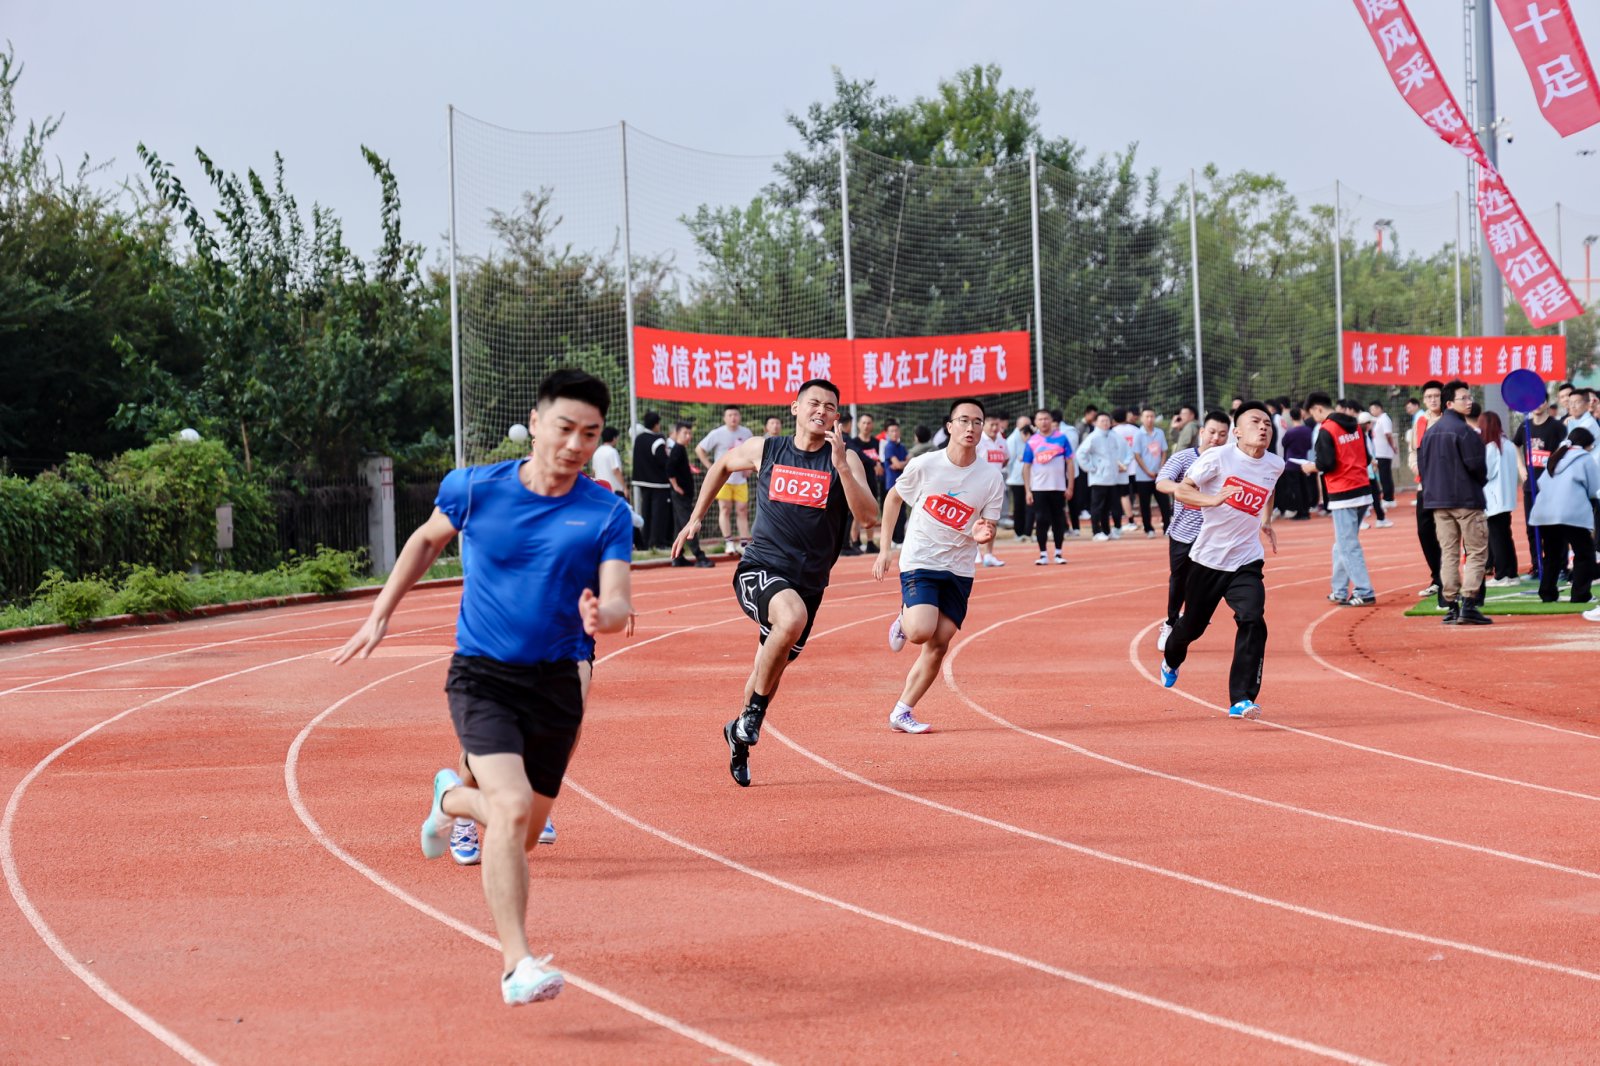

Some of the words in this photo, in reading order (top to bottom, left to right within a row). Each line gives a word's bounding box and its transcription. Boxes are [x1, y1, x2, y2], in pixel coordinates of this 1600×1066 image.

[1513, 2, 1588, 108] 十足
[650, 343, 832, 393] 激情在运动中点燃
[861, 344, 1008, 391] 事业在工作中高飞
[1351, 341, 1410, 376] 快乐工作
[1428, 344, 1483, 376] 健康生活
[1496, 343, 1554, 374] 全面发展
[774, 476, 824, 499] 0623
[1229, 489, 1263, 511] 002
[929, 499, 967, 523] 1407
